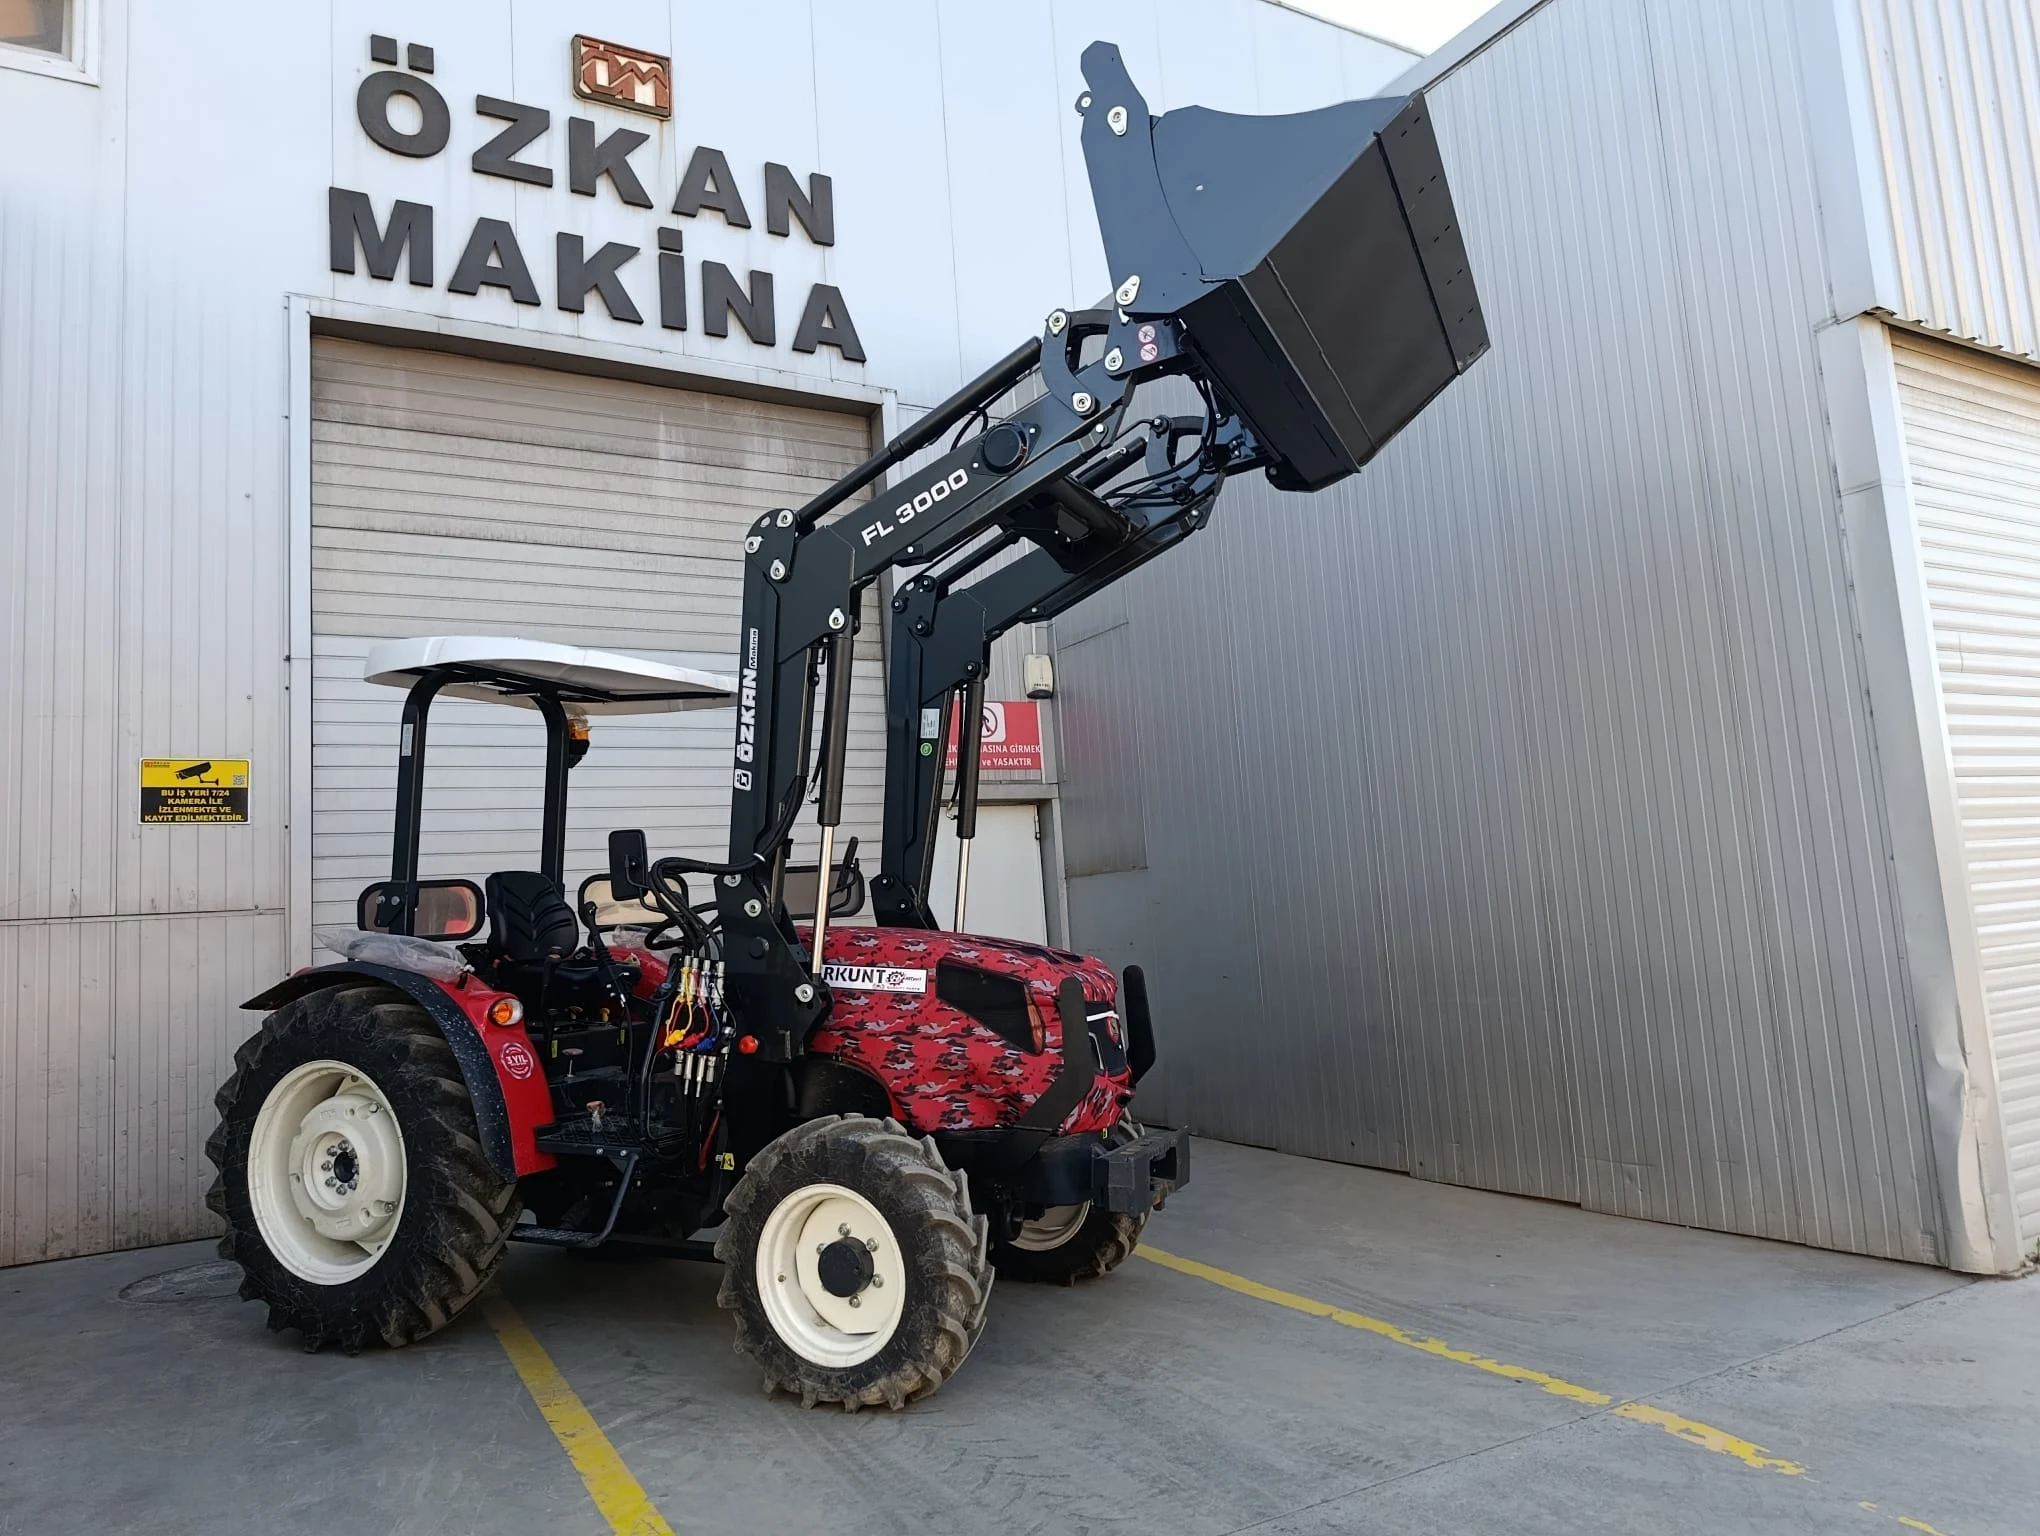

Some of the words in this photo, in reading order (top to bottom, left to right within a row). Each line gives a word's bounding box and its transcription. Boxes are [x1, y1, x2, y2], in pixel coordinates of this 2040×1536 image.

[357, 33, 835, 246] ÖZKAN
[329, 186, 867, 363] MAKİNA
[861, 520, 895, 546] FL
[895, 468, 969, 524] 3000
[736, 668, 757, 763] ÖZKAN
[981, 745, 1008, 753] ASINA
[1009, 743, 1040, 753] GİRMEK
[992, 758, 1032, 766] YASAKTIR
[188, 788, 209, 796] YERİ
[209, 797, 223, 805] İLE
[159, 805, 217, 813] İZLENMEKTE
[823, 966, 886, 984] RKUNT
